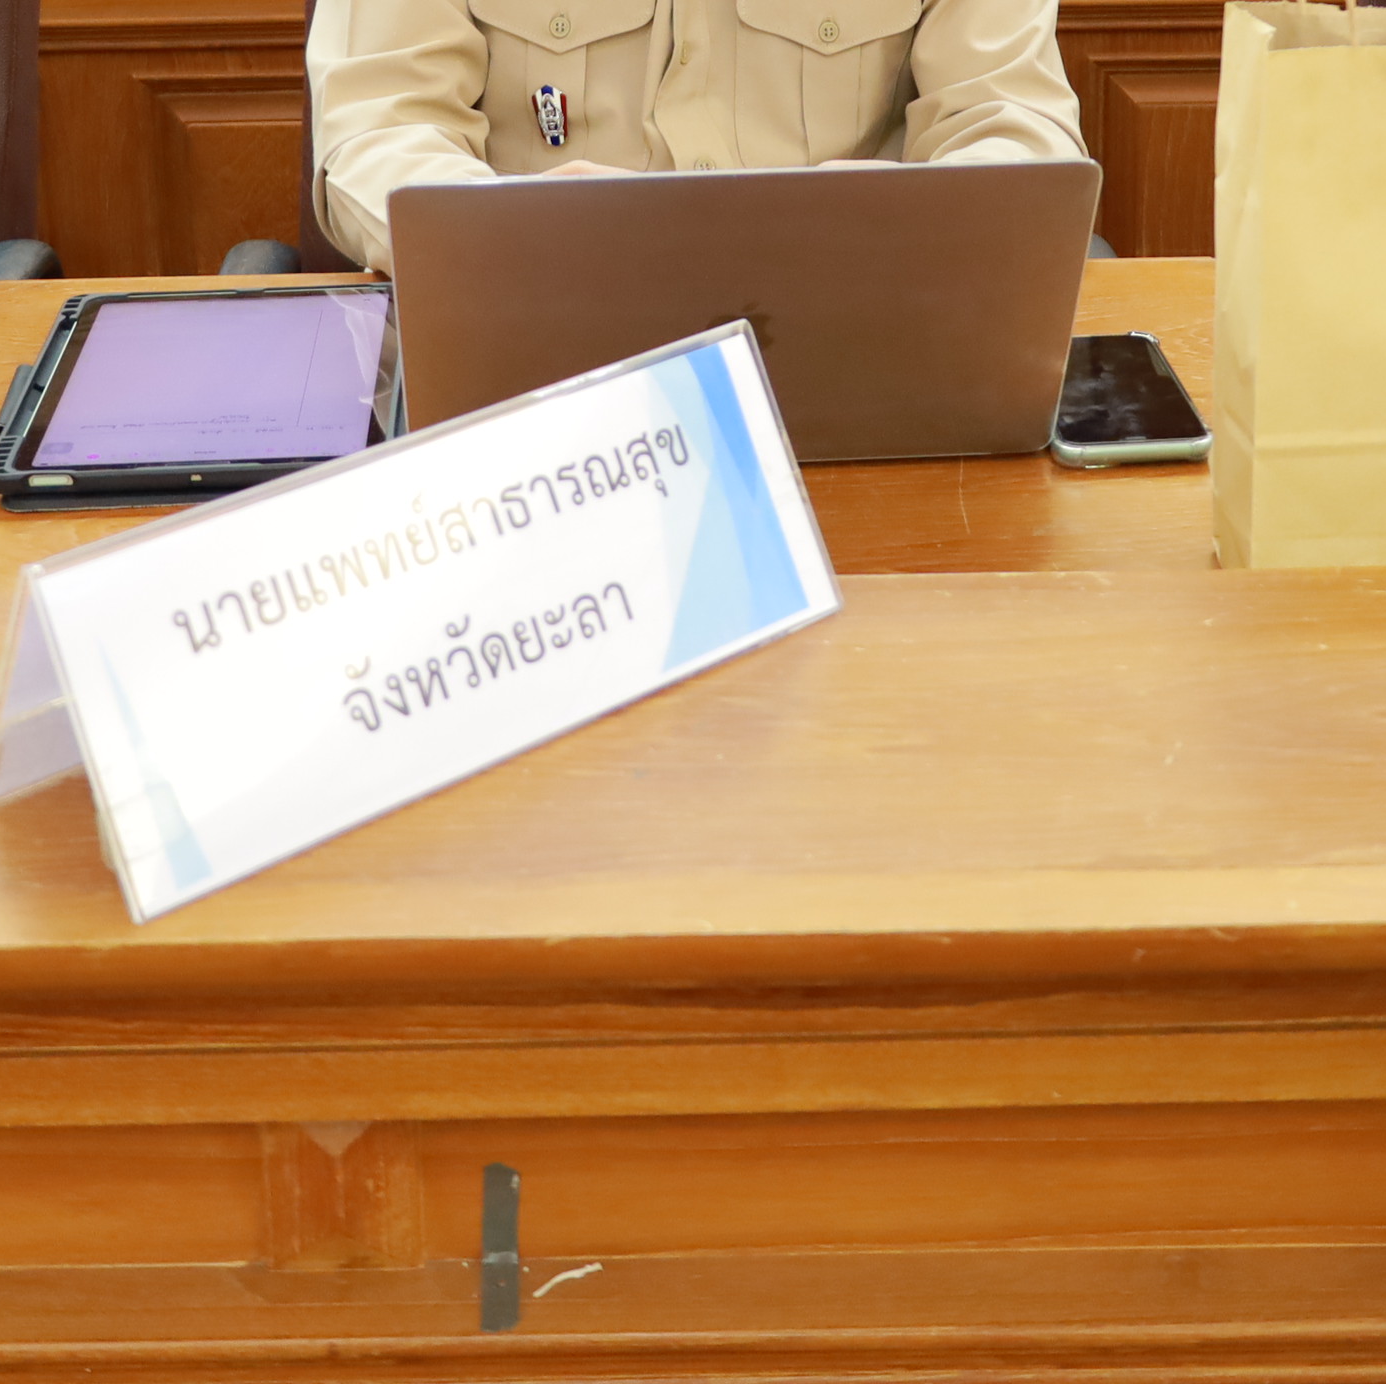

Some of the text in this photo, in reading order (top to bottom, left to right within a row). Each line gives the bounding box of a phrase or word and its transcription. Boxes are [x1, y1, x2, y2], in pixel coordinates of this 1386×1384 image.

[171, 419, 692, 656] นายแพทย์สาธารณสุข
[342, 575, 635, 734] จังหวัดยะลา
